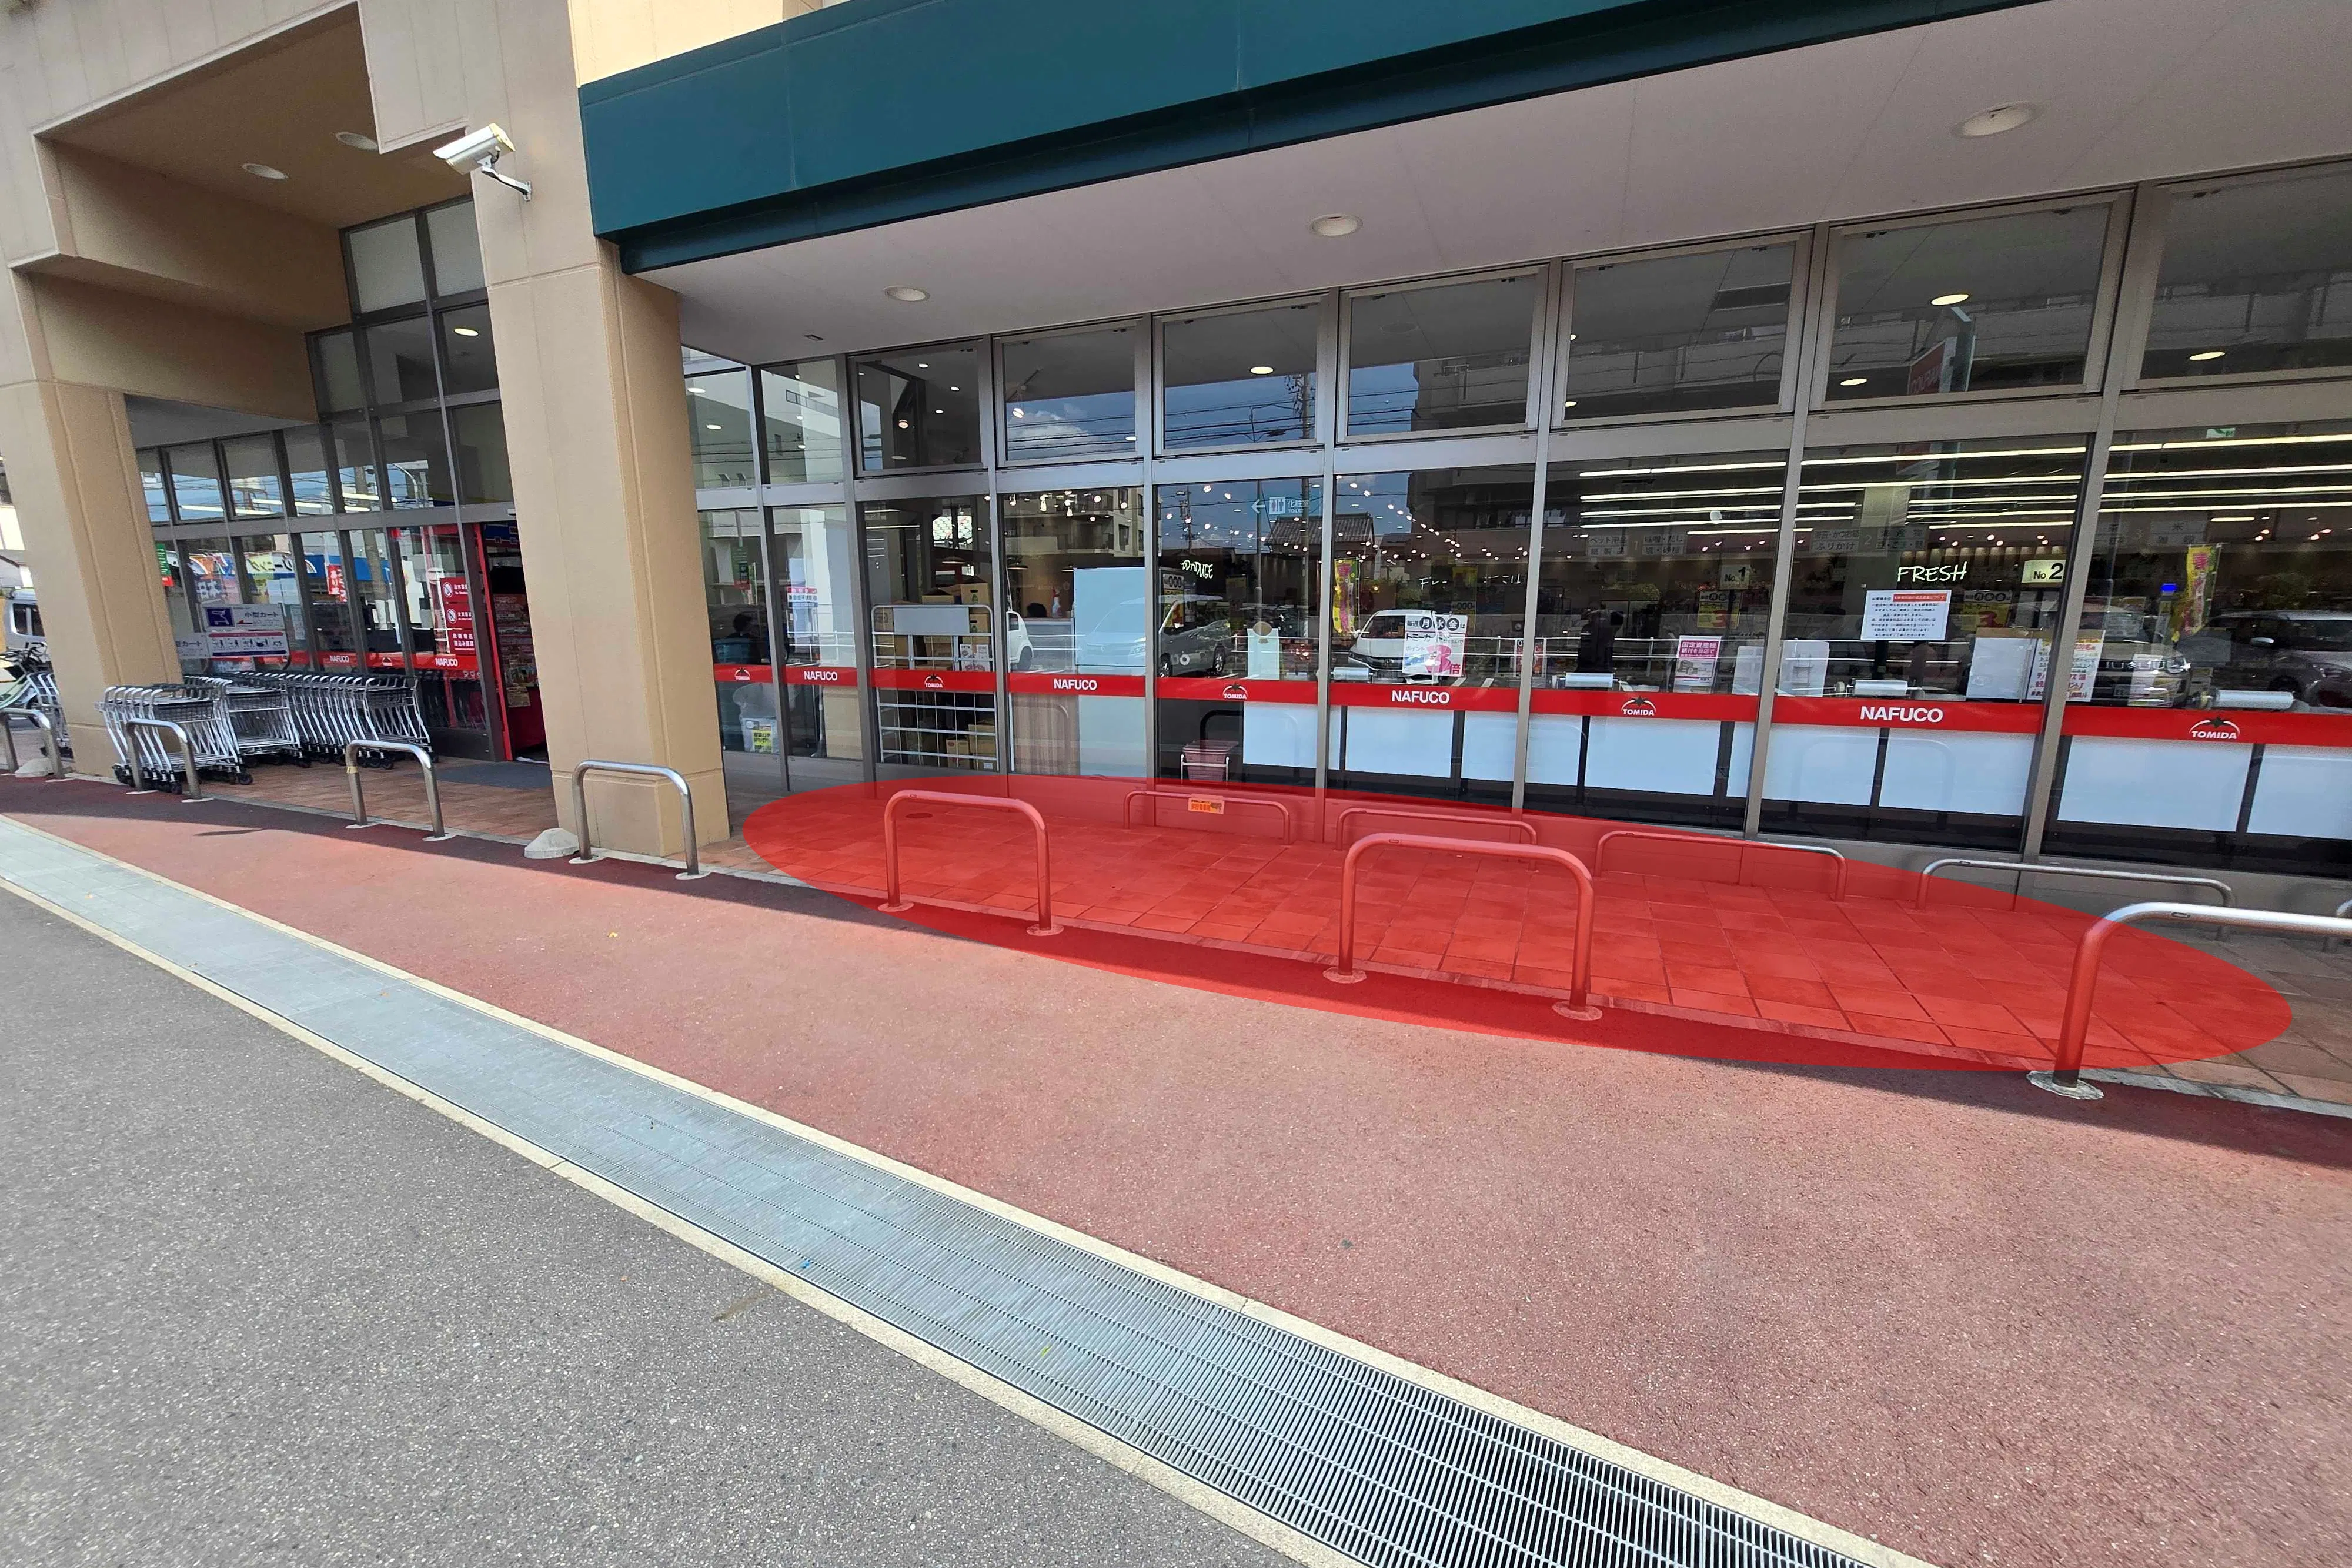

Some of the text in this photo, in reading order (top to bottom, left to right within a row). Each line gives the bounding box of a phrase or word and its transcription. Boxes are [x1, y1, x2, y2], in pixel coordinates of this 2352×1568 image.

[1897, 561, 1967, 582] FRESH
[2033, 563, 2064, 580] No.2
[329, 654, 350, 663] NAFUCO
[435, 657, 458, 667] NAFUCO
[803, 670, 838, 681] NAFUCO
[1054, 678, 1097, 691] NAFUCO
[1391, 690, 1450, 704] NAFUCO
[1622, 708, 1655, 716] TOMIDA
[1860, 706, 1943, 723] NAFUCO
[2191, 730, 2237, 740] TOMIDA
